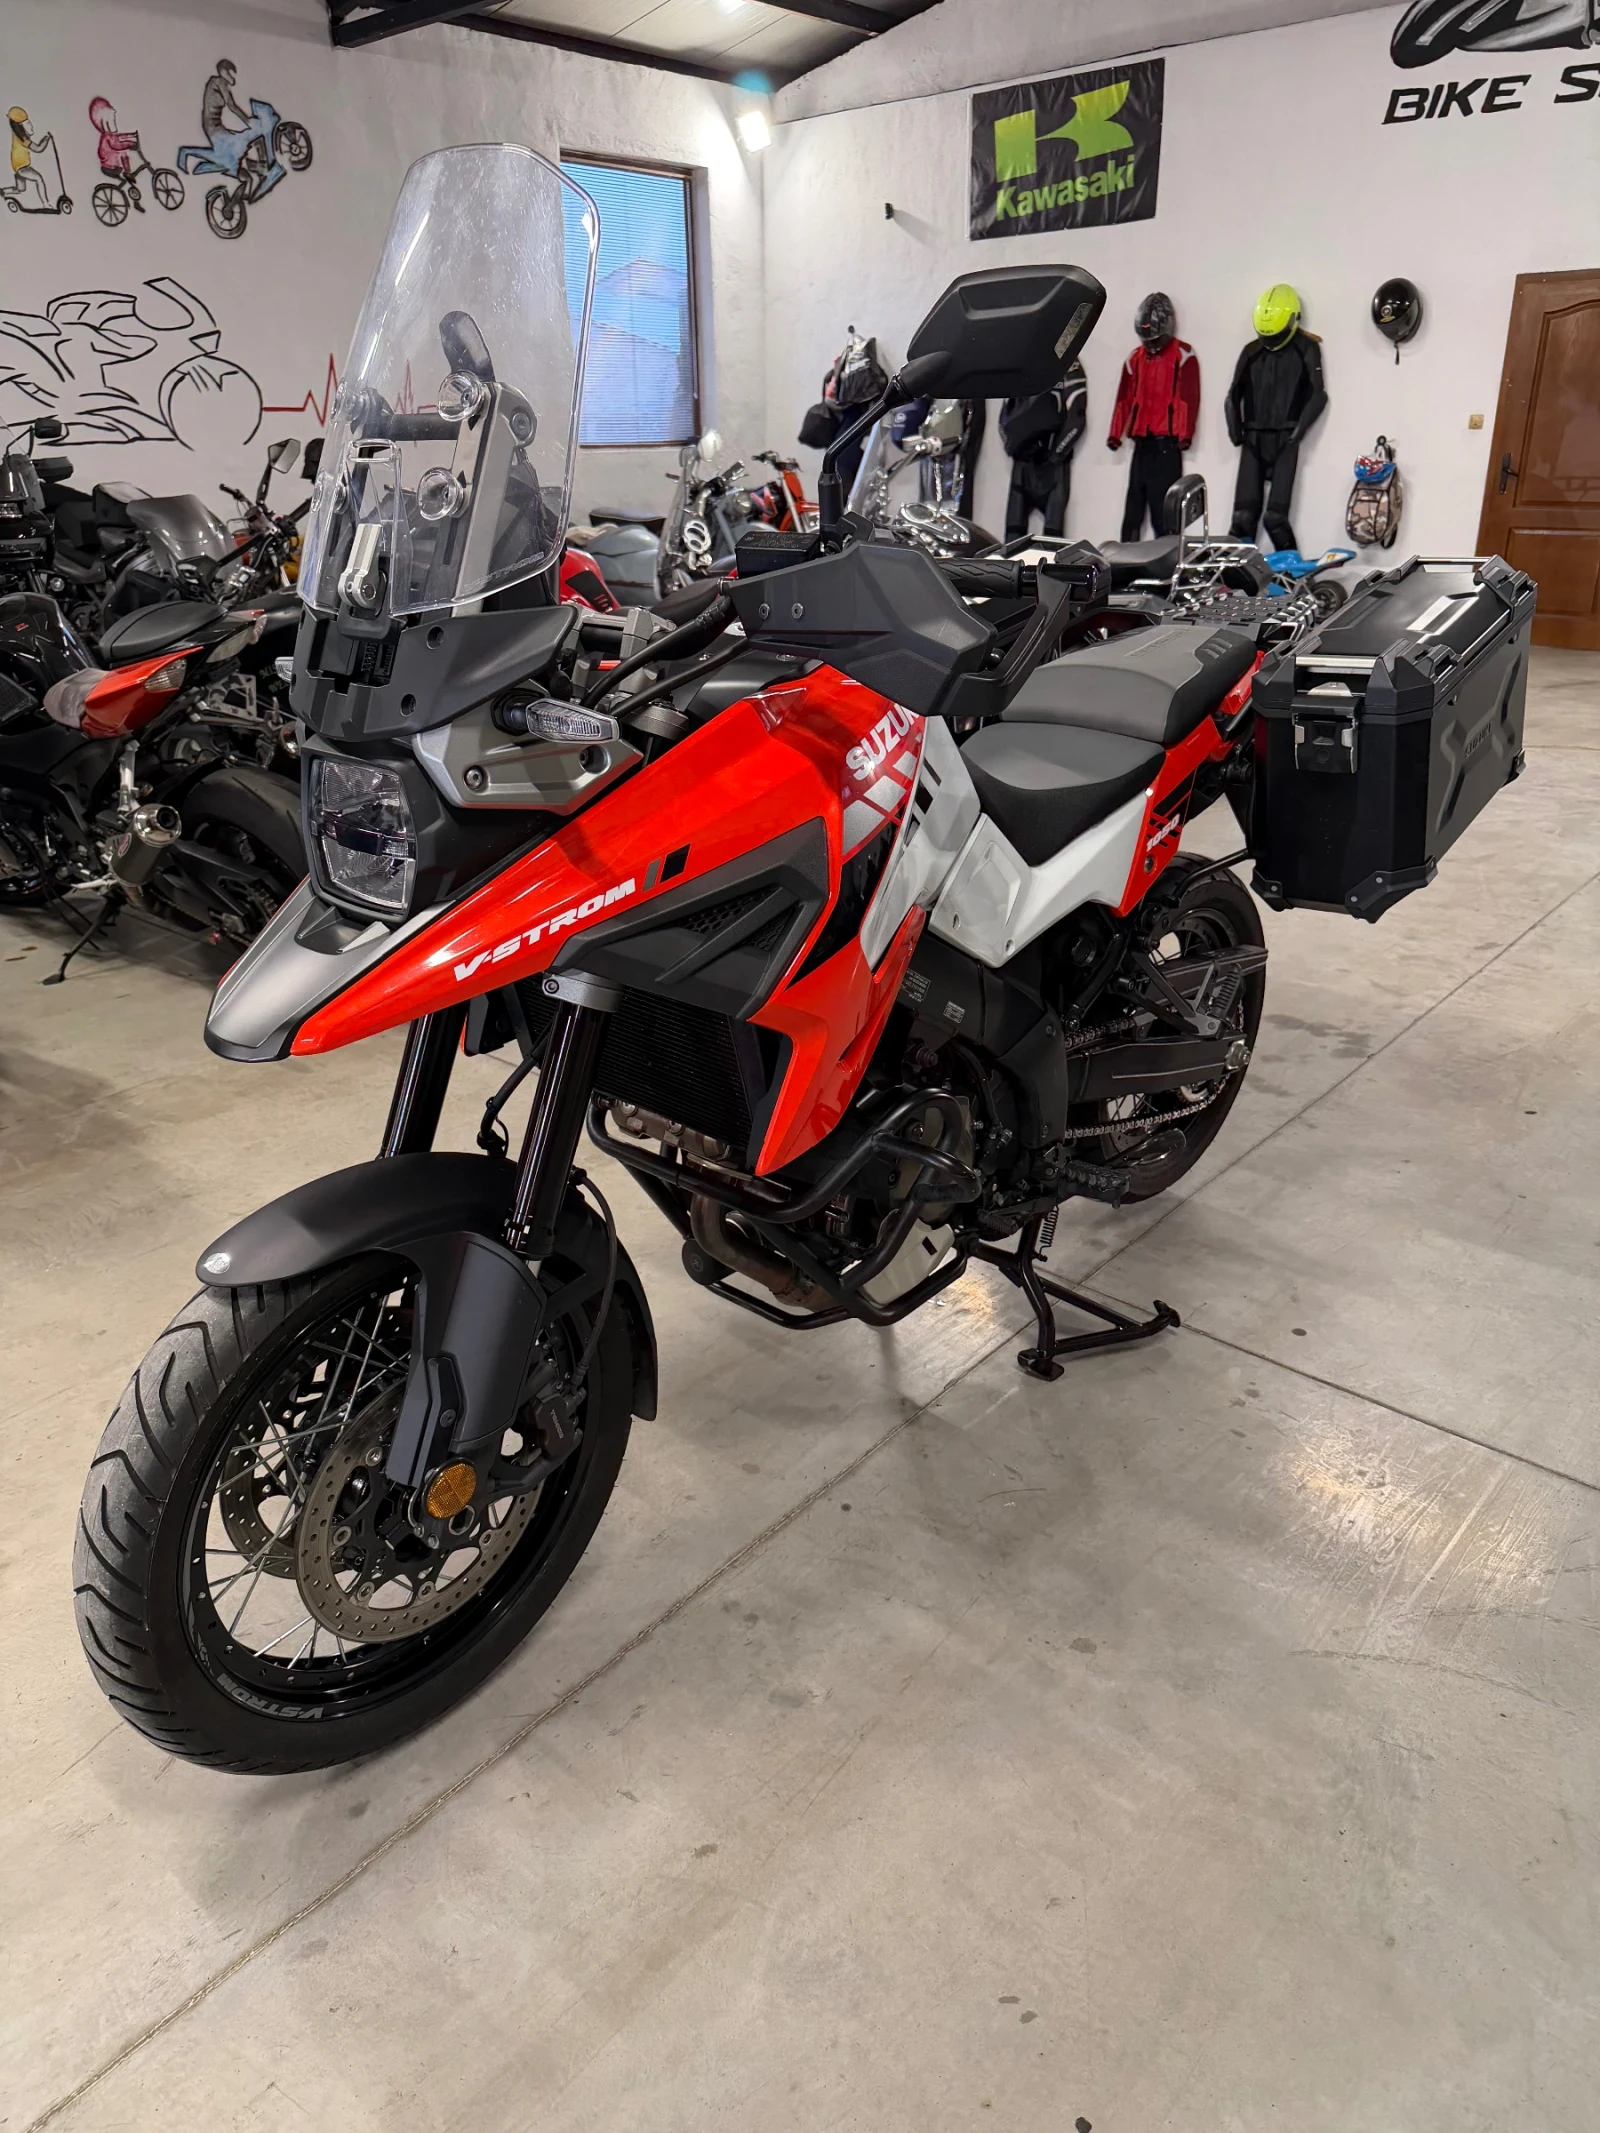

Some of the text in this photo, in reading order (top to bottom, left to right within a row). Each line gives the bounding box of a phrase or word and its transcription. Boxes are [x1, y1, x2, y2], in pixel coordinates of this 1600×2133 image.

[1381, 62, 1600, 124] BIKE S
[995, 154, 1136, 221] Kawasaki
[845, 702, 920, 781] SUZUK
[1146, 813, 1181, 853] 1050
[453, 877, 636, 982] V-STROM
[216, 1672, 325, 1719] V-STROM
